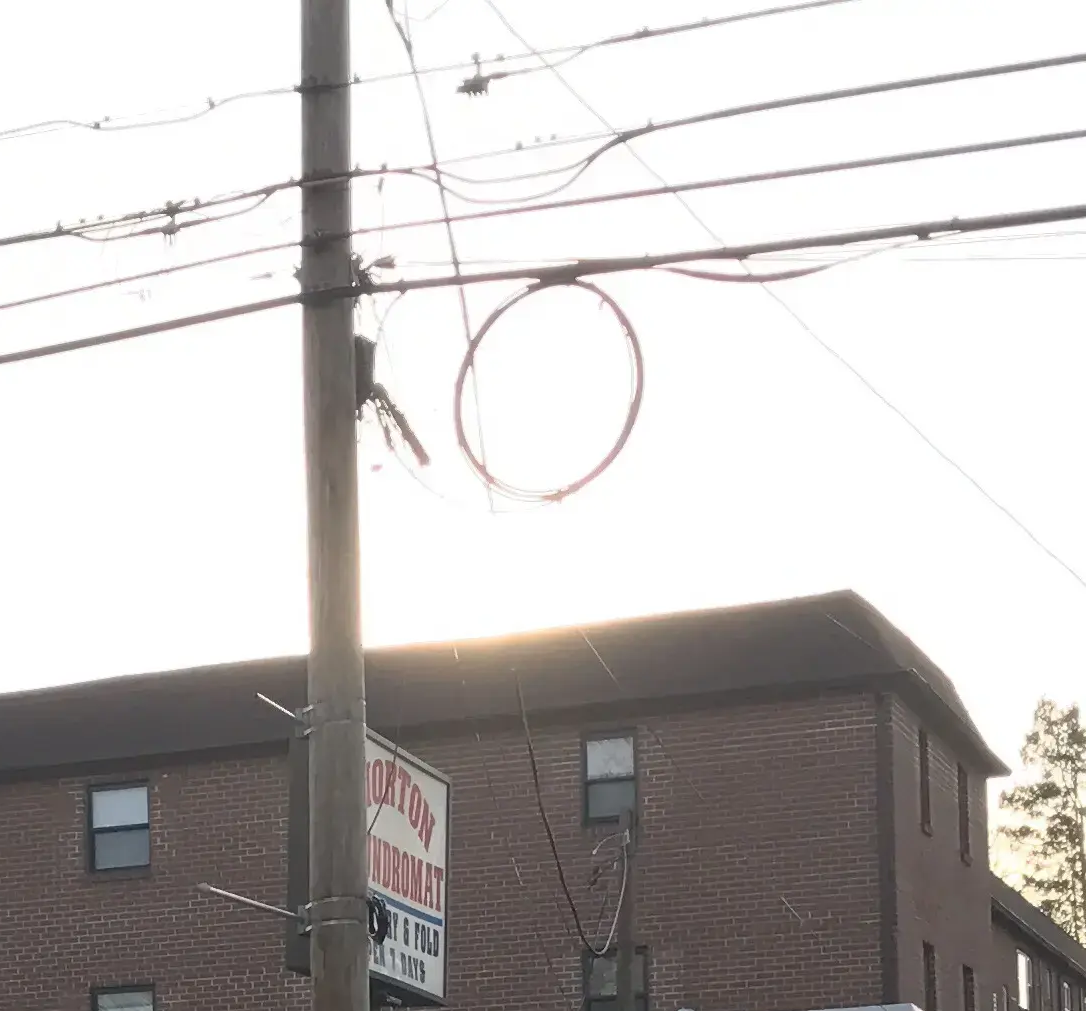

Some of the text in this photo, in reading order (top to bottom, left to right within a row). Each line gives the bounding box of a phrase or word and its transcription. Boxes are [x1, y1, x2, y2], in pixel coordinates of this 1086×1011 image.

[366, 833, 444, 913] NDROMAT
[414, 921, 440, 958] FOLD
[389, 947, 396, 972] 7
[400, 951, 426, 984] DAYS
